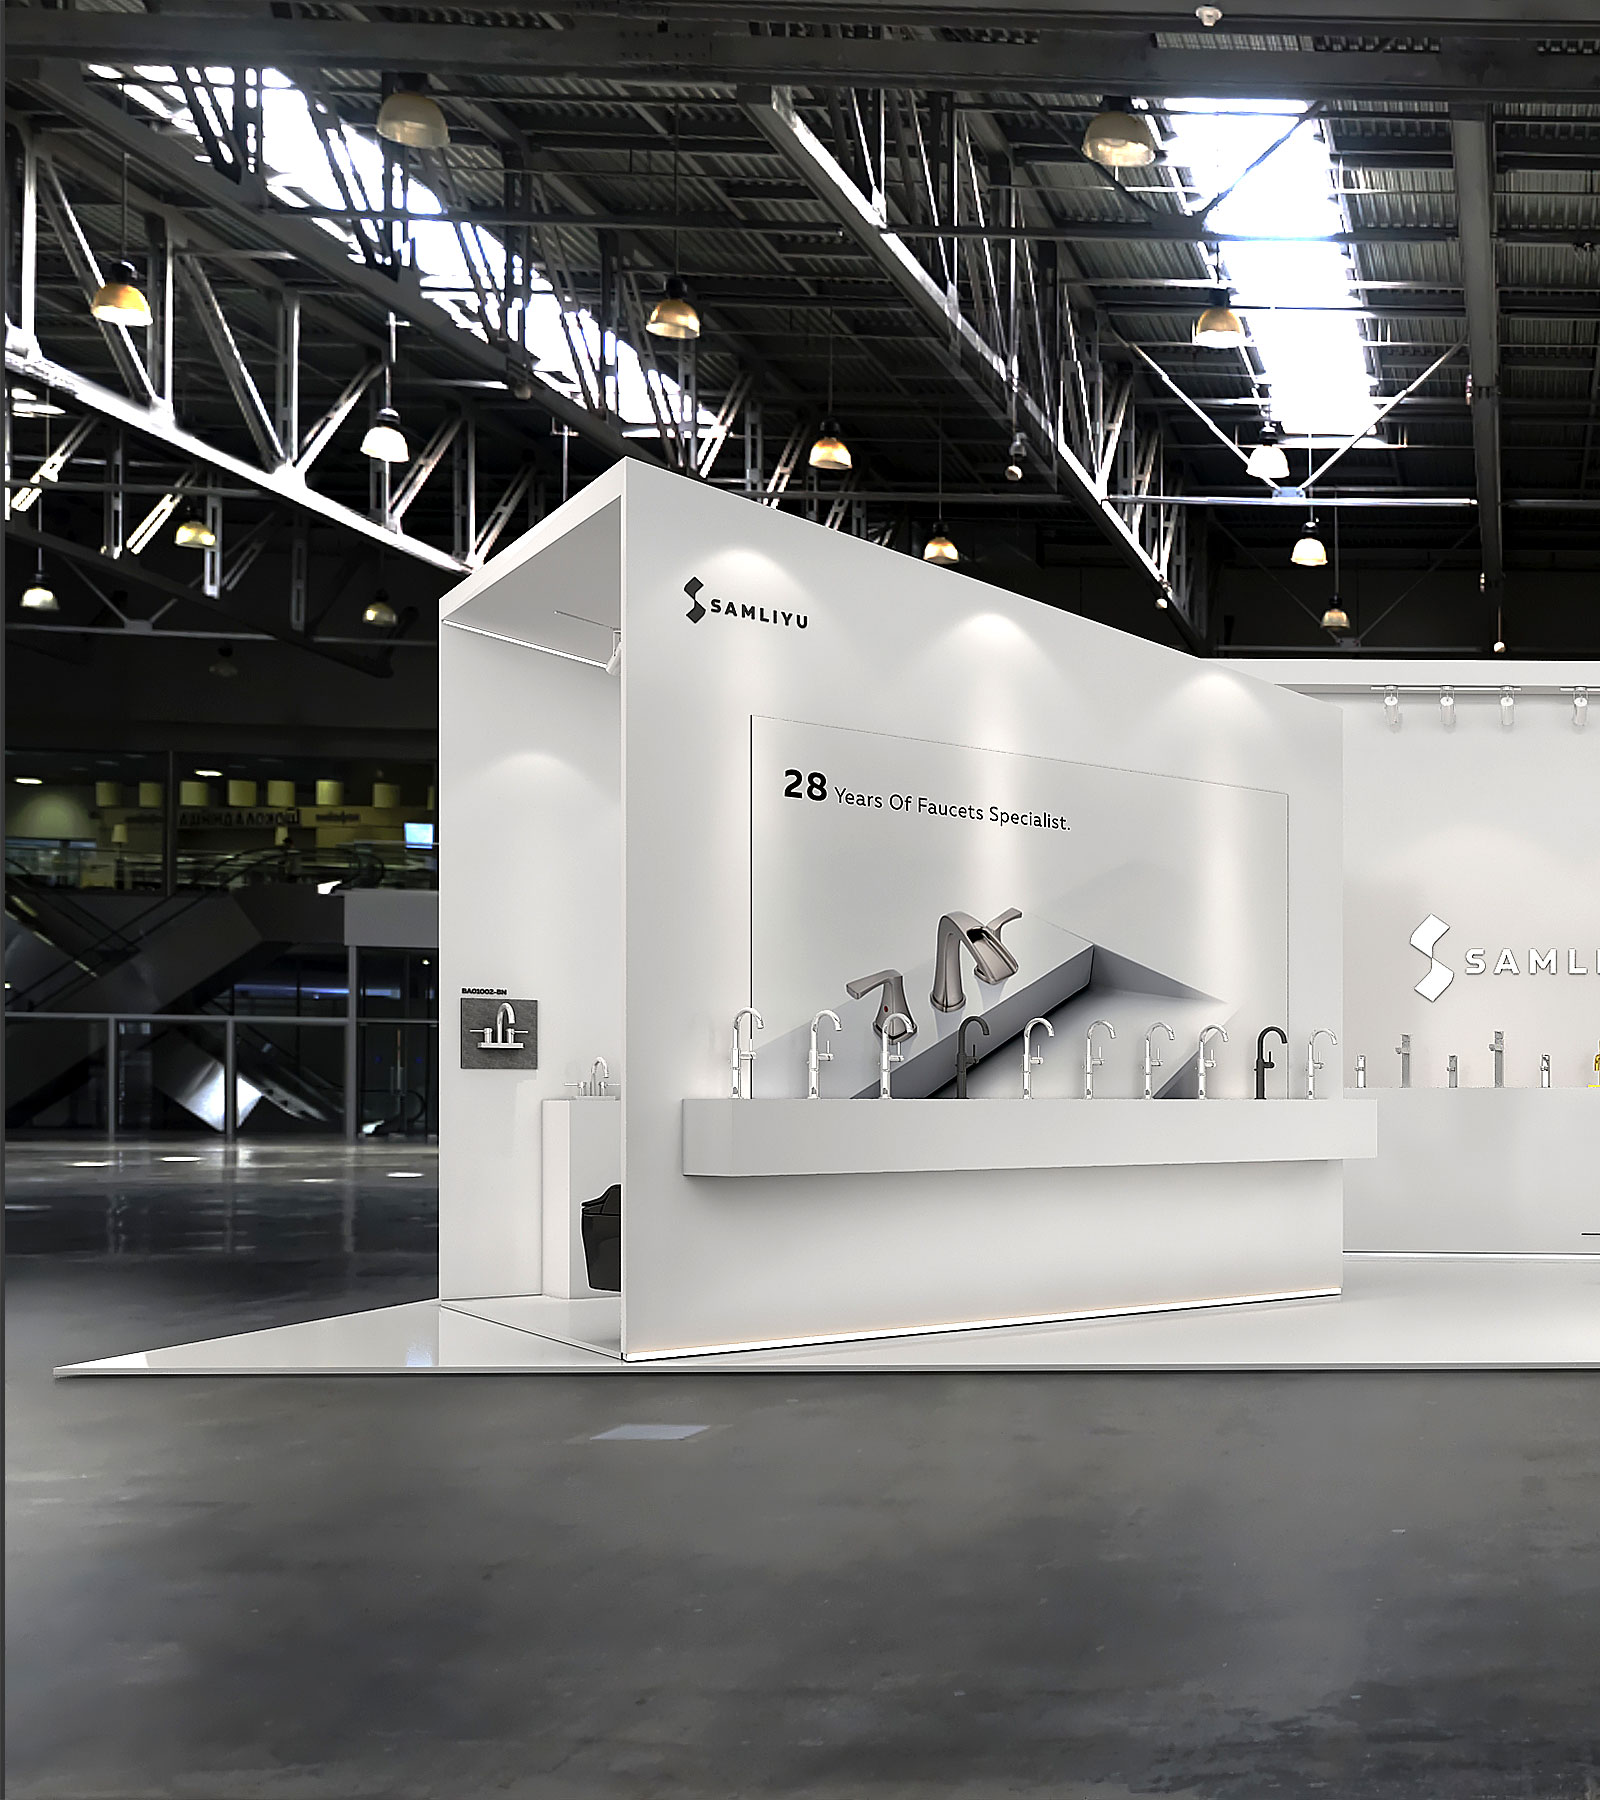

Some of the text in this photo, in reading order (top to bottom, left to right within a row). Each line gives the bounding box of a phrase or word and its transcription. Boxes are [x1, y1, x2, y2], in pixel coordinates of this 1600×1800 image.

[710, 599, 809, 629] SAMLIYU
[783, 769, 1071, 832] 28 Years Of Faucets Specialist.
